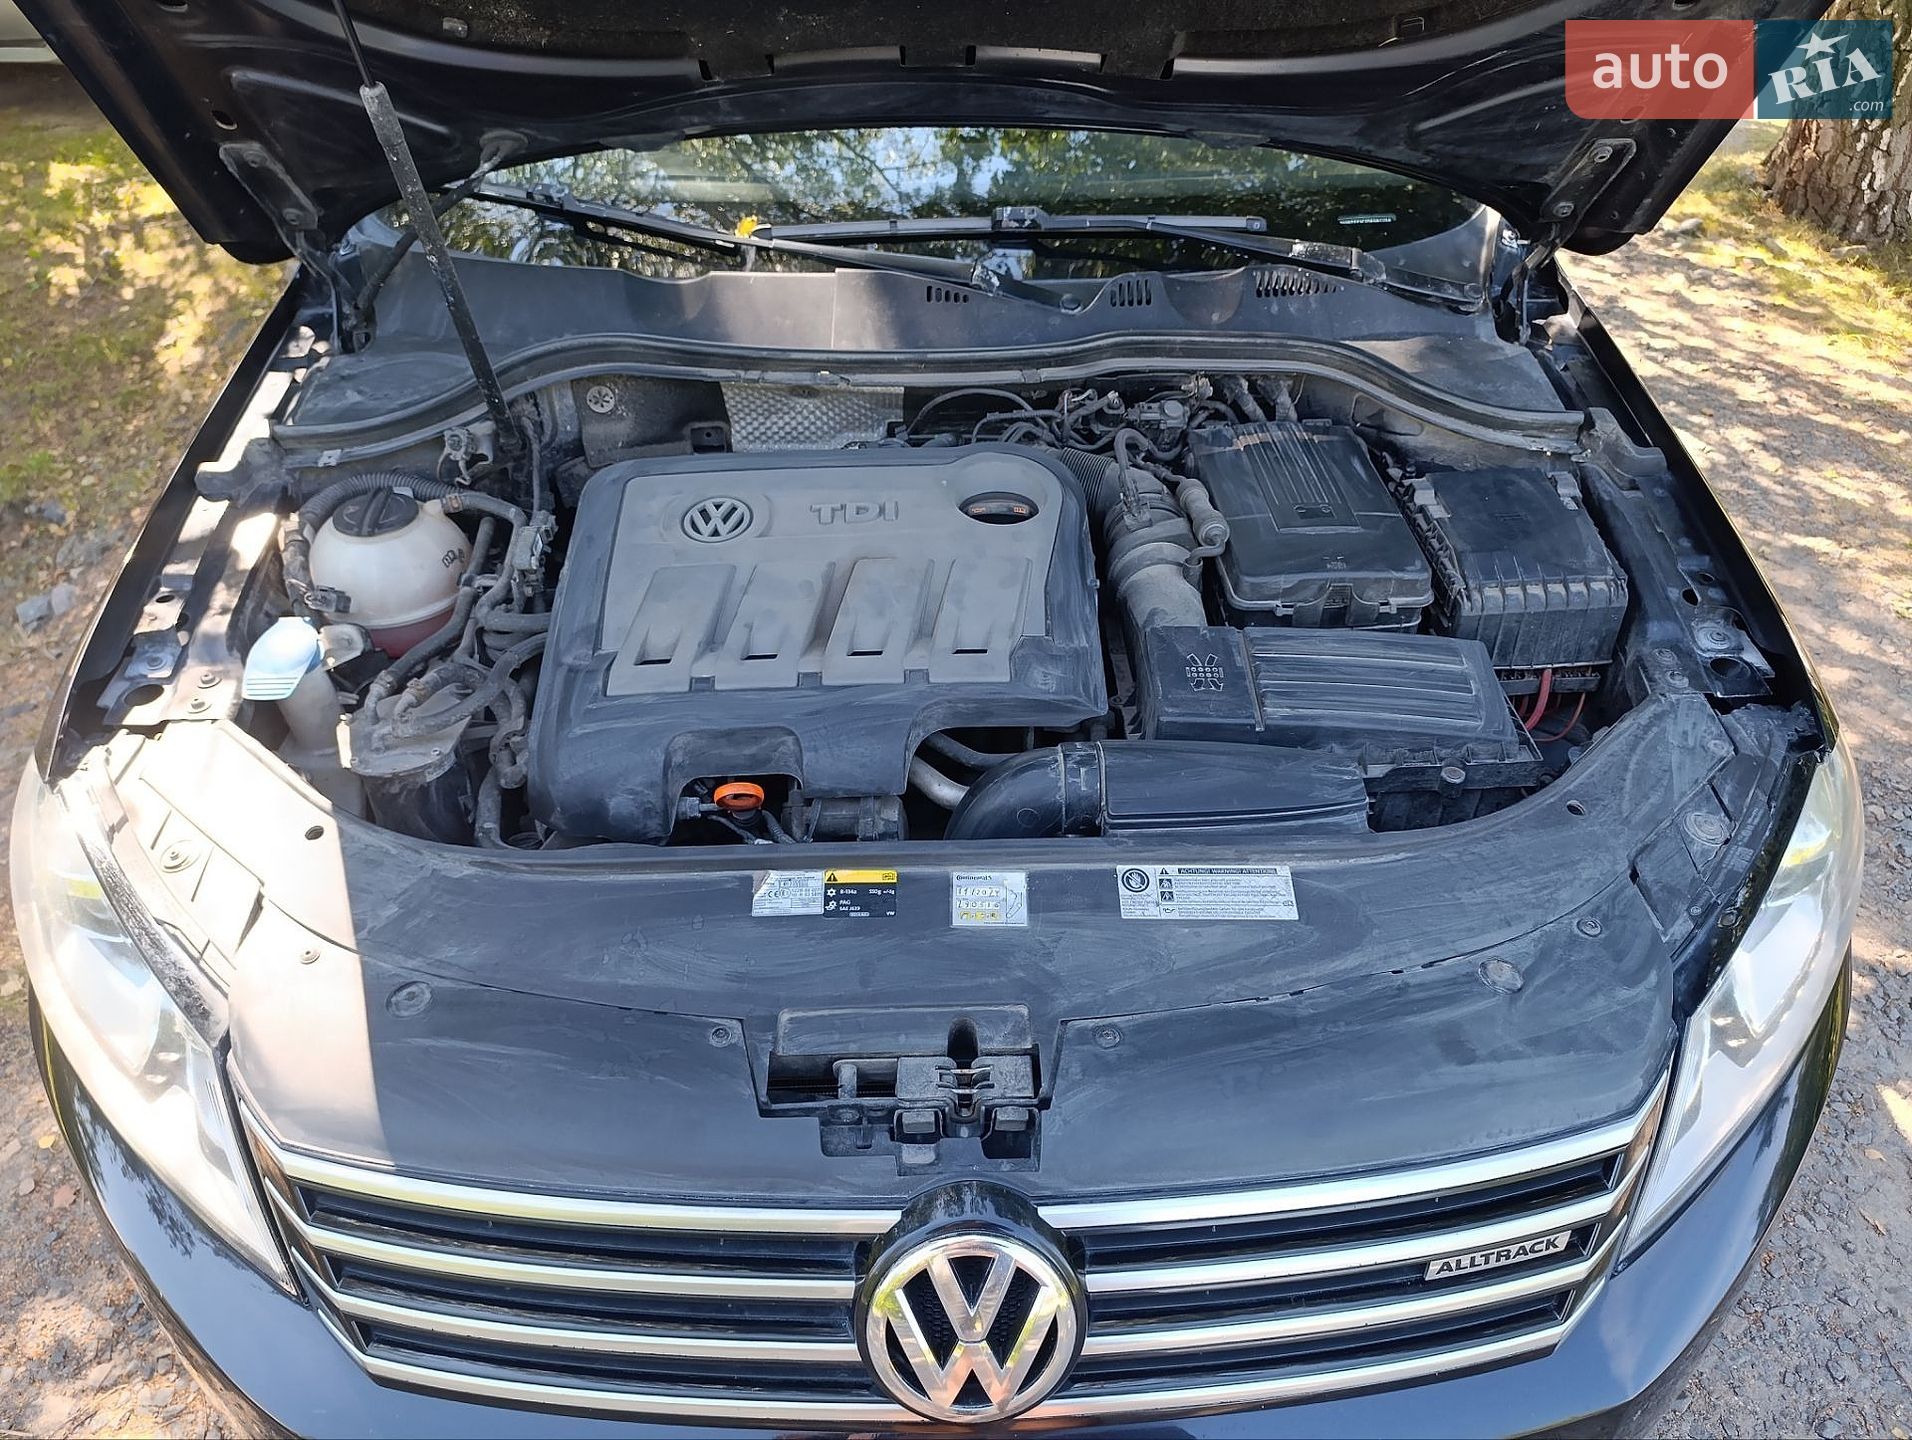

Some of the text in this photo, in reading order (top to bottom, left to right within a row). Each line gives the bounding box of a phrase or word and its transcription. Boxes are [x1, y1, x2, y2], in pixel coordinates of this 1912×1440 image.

[683, 497, 751, 542] VW
[810, 501, 899, 525] TDI
[1435, 1235, 1560, 1275] ALLTRACK
[873, 1240, 1070, 1418] VW
